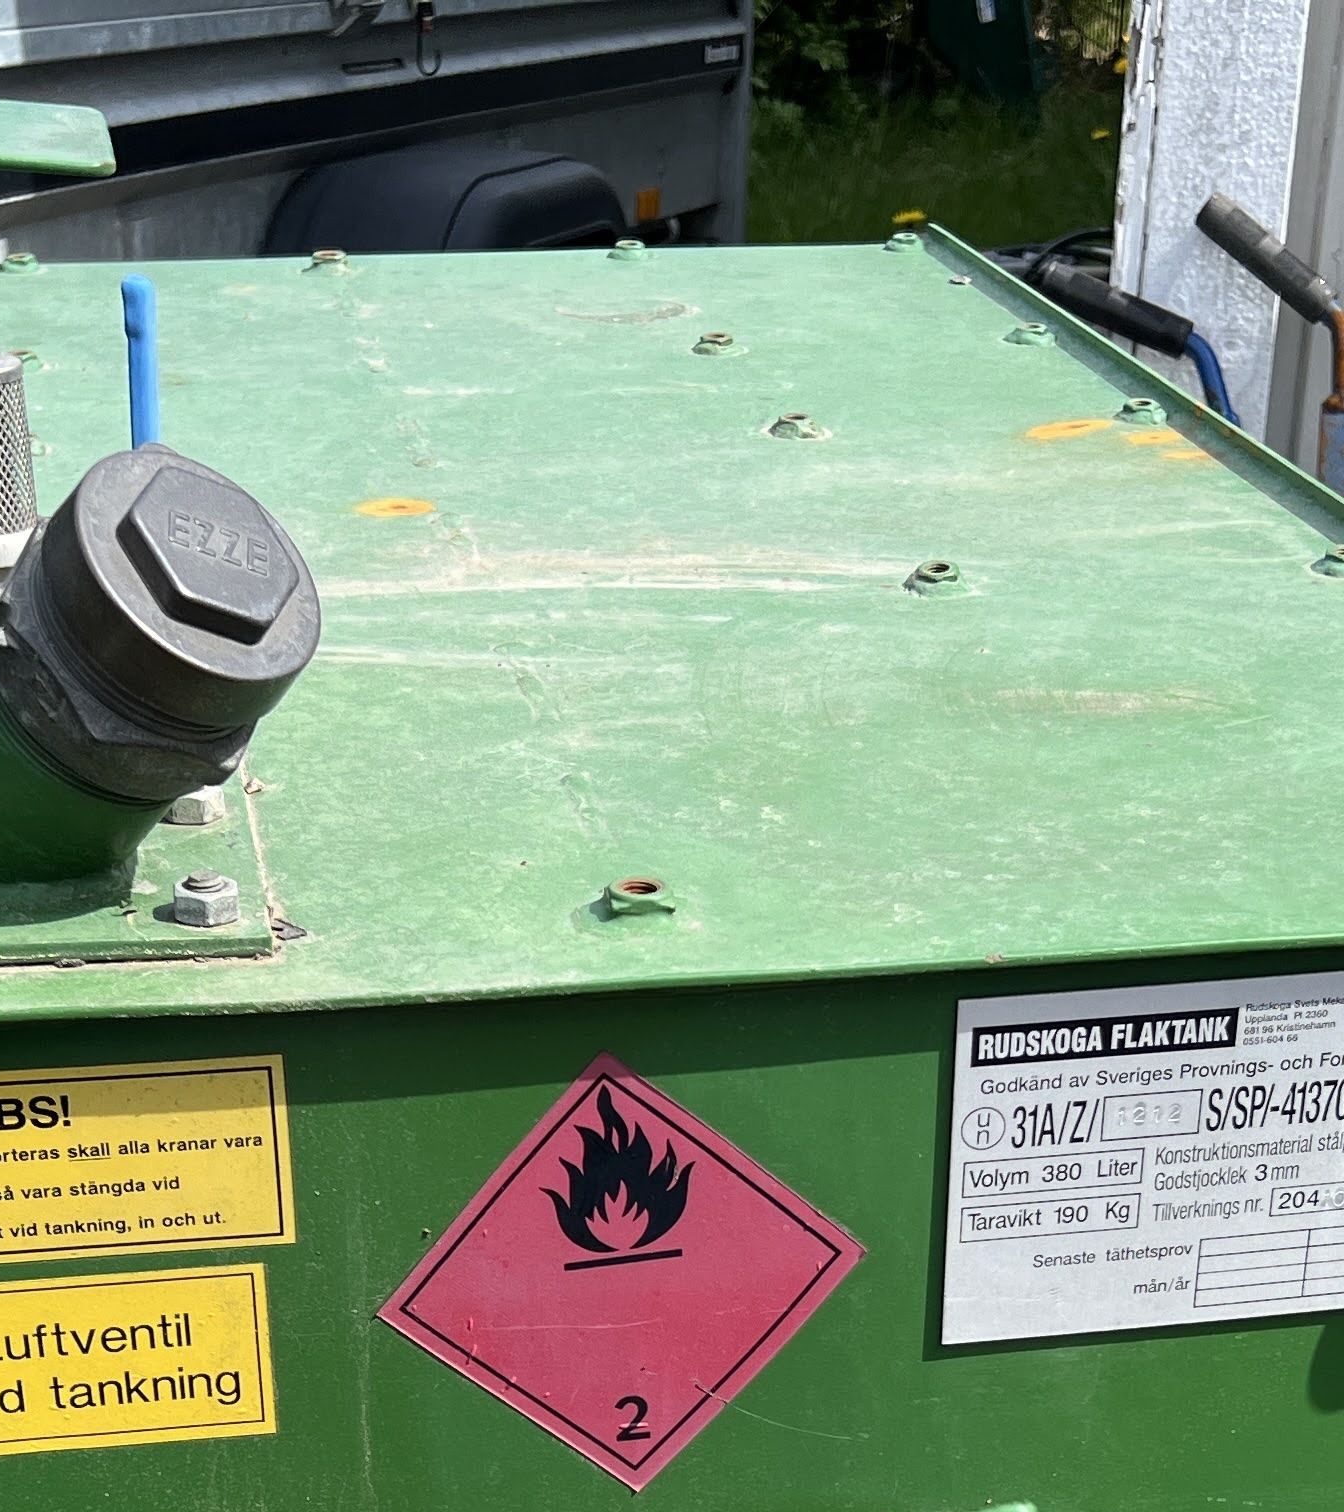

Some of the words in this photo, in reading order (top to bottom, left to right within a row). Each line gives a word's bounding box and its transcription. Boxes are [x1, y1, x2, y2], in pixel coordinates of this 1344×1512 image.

[168, 510, 268, 577] EZZE
[978, 1025, 1103, 1060] RUDSKOGA
[1110, 1015, 1232, 1050] FLAKTANK
[980, 1074, 1063, 1095] Godkänd
[1069, 1075, 1090, 1088] av
[1096, 1066, 1173, 1086] Sveriges
[1180, 1059, 1274, 1079] Provnings-
[1280, 1054, 1313, 1071] och
[1011, 1099, 1100, 1148] 31A/Z/
[67, 1142, 111, 1161] skall
[118, 1140, 150, 1155] alla
[157, 1136, 218, 1153] kranar
[224, 1135, 263, 1149] vara
[1154, 1134, 1313, 1166] Konstruktionsmaterial
[21, 1186, 62, 1199] vara
[69, 1178, 146, 1197] stängda
[152, 1176, 180, 1191] vid
[969, 1168, 1029, 1191] Volym
[1042, 1162, 1082, 1183] 380
[1097, 1157, 1138, 1178] Liter
[1154, 1167, 1247, 1192] Godstjocklek
[1254, 1164, 1268, 1181] 3
[1270, 1164, 1300, 1181] mm
[9, 1222, 38, 1237] vid
[45, 1218, 132, 1236] tankning,
[138, 1215, 155, 1229] in
[162, 1212, 196, 1228] och
[203, 1211, 227, 1225] ut.
[967, 1208, 1043, 1231] Taravikt
[1054, 1205, 1089, 1225] 190
[1105, 1200, 1131, 1223] Kg
[1152, 1198, 1241, 1222] Tillverknings
[1244, 1197, 1265, 1214] nr.
[1033, 1251, 1096, 1268] Senaste
[1106, 1243, 1194, 1263] täthetsprov
[1133, 1277, 1191, 1294] mån/år
[49, 1366, 242, 1409] tankning
[614, 1395, 651, 1442] 2
